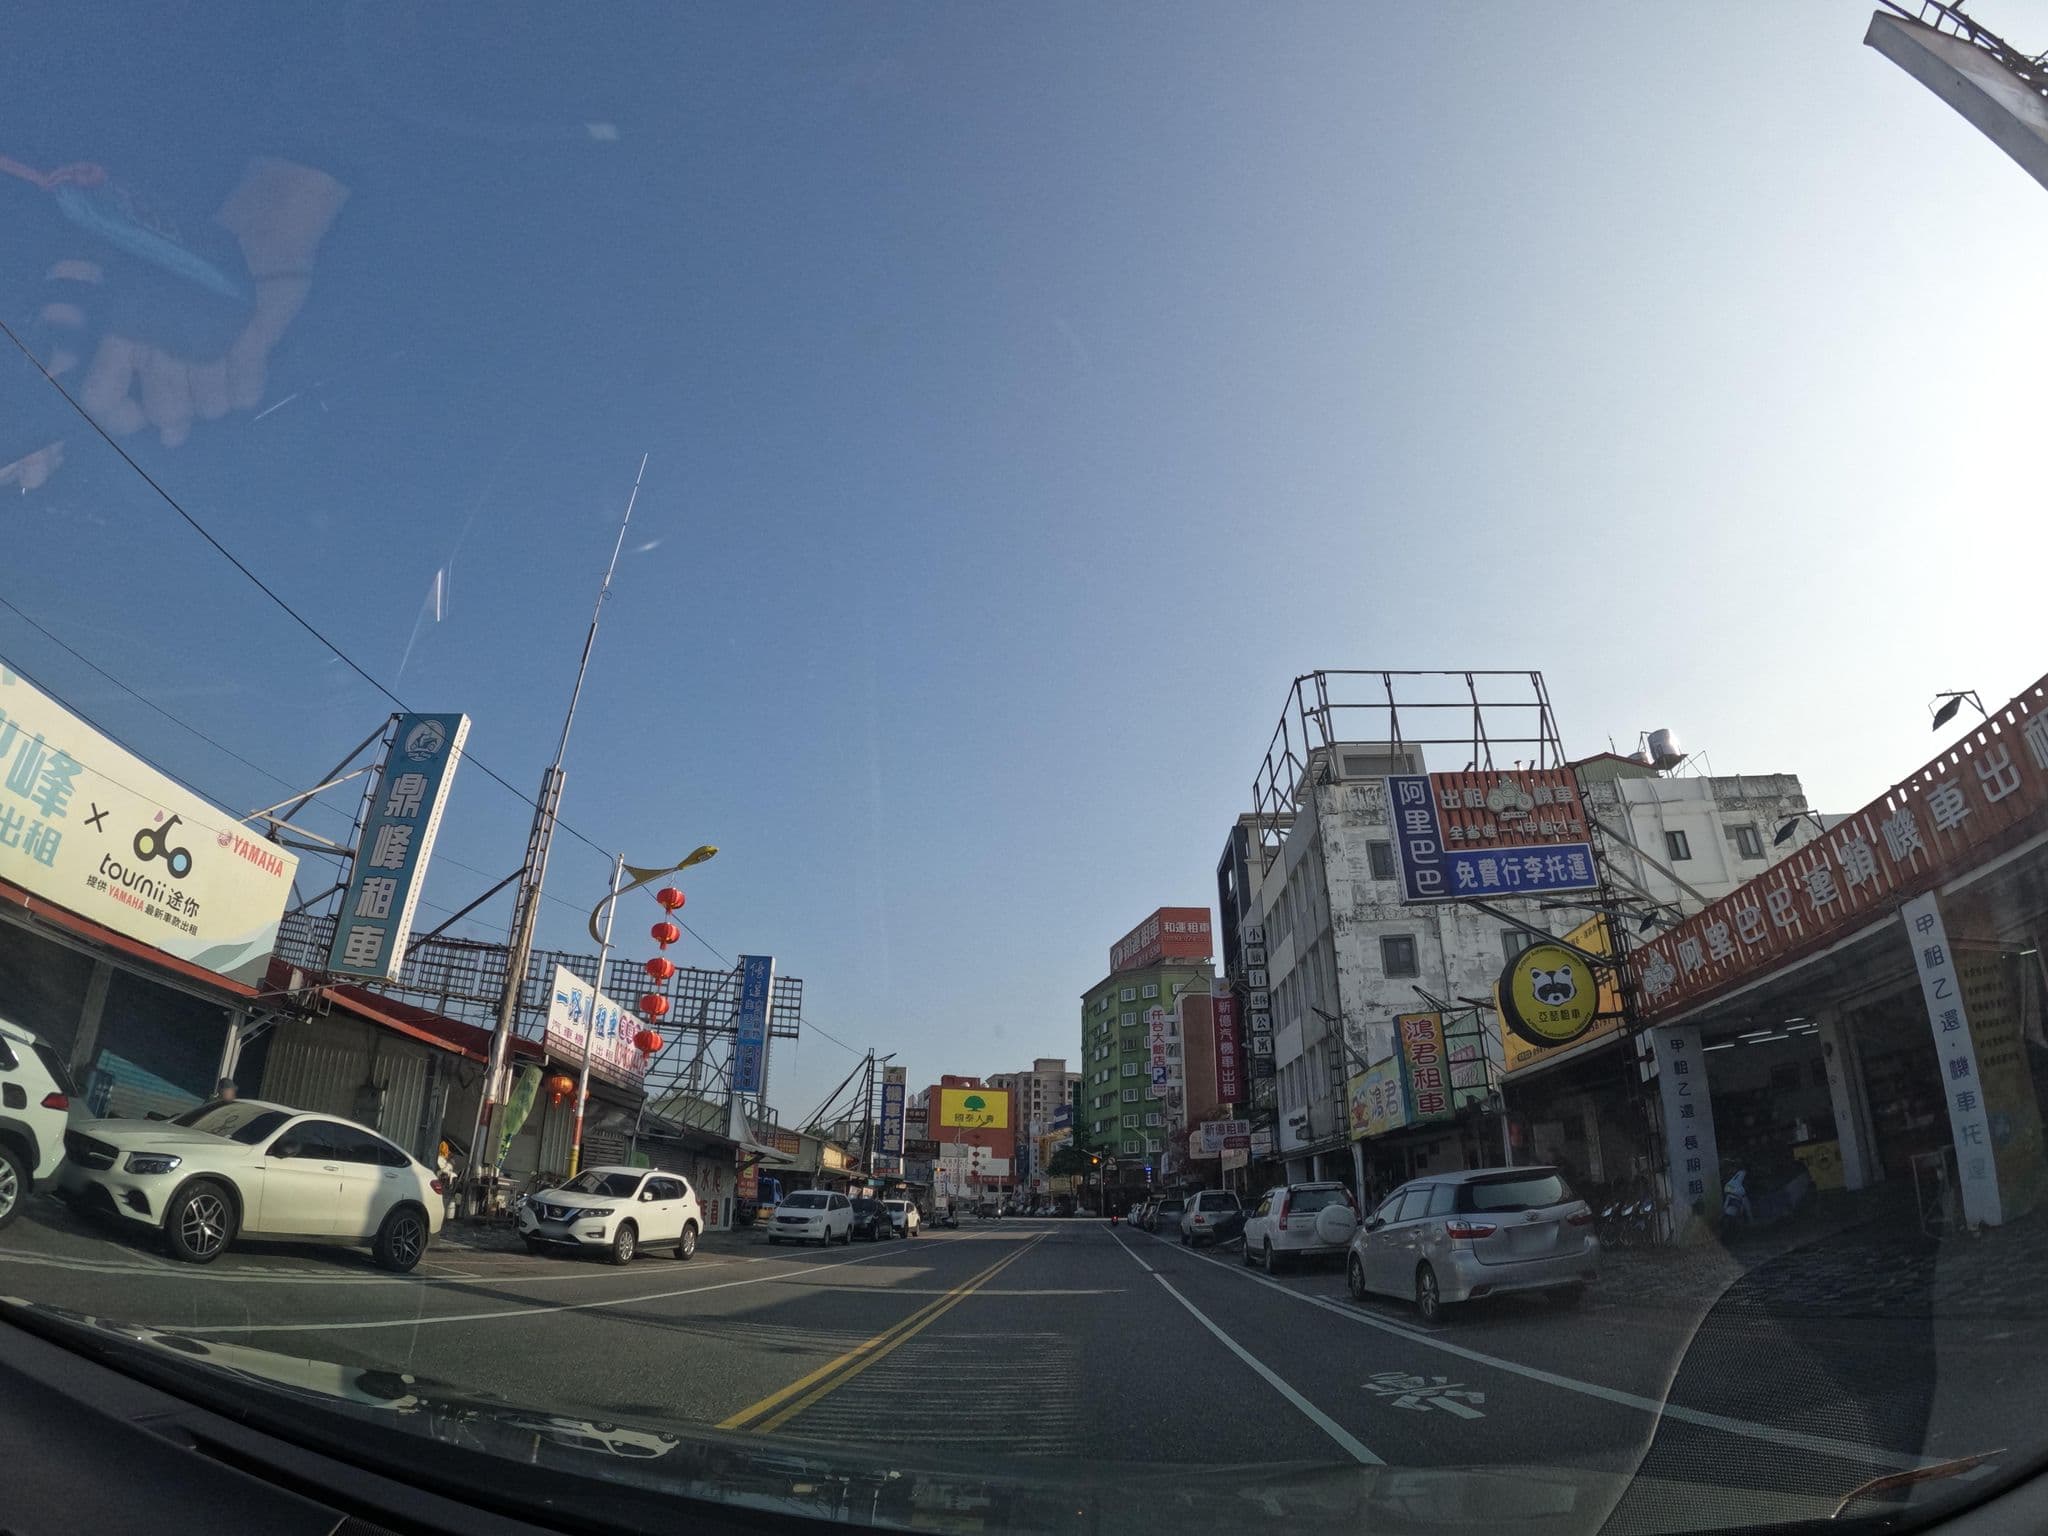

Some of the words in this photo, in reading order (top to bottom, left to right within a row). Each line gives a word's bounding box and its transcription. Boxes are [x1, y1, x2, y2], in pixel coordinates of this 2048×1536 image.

[1440, 788, 1486, 810] 出租
[231, 834, 285, 878] YAMAHA
[1398, 780, 1445, 895] 阿里巴巴
[99, 852, 167, 903] tournii
[166, 886, 201, 918] 途你
[343, 773, 428, 968] 鼎峰租車
[1455, 853, 1589, 889] 免費行李托運
[86, 874, 108, 893] 提供
[108, 884, 145, 912] YAMAHA
[144, 903, 199, 937] 最新車款出租
[551, 1018, 615, 1064] 汽車機出租
[1405, 1018, 1446, 1116] 鴻君租車
[954, 1113, 995, 1124] 國泰人壽
